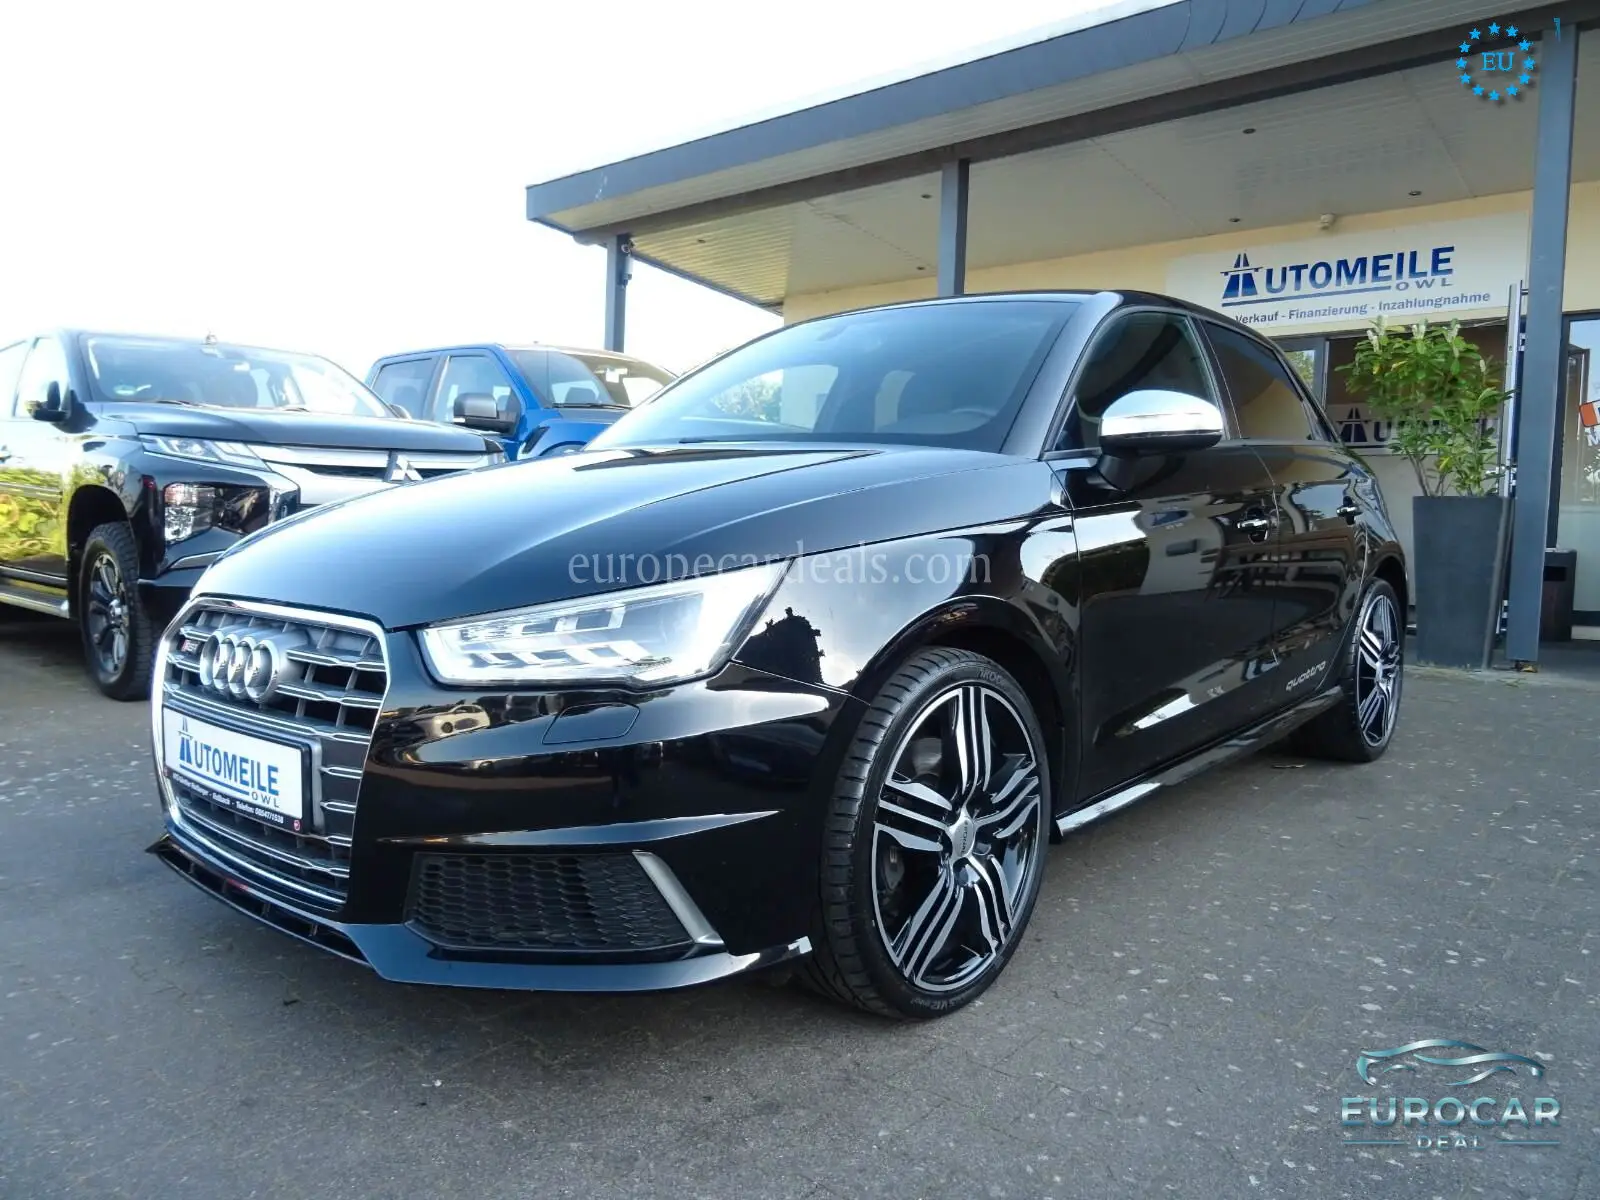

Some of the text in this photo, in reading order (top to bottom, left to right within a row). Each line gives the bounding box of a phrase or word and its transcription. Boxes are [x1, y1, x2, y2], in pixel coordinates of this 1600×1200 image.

[1395, 277, 1454, 291] OWL
[1235, 311, 1279, 324] Verkauf
[1288, 303, 1368, 319] Finanzierung
[1378, 292, 1491, 311] Inzahlungnahme
[251, 791, 280, 808] OWL
